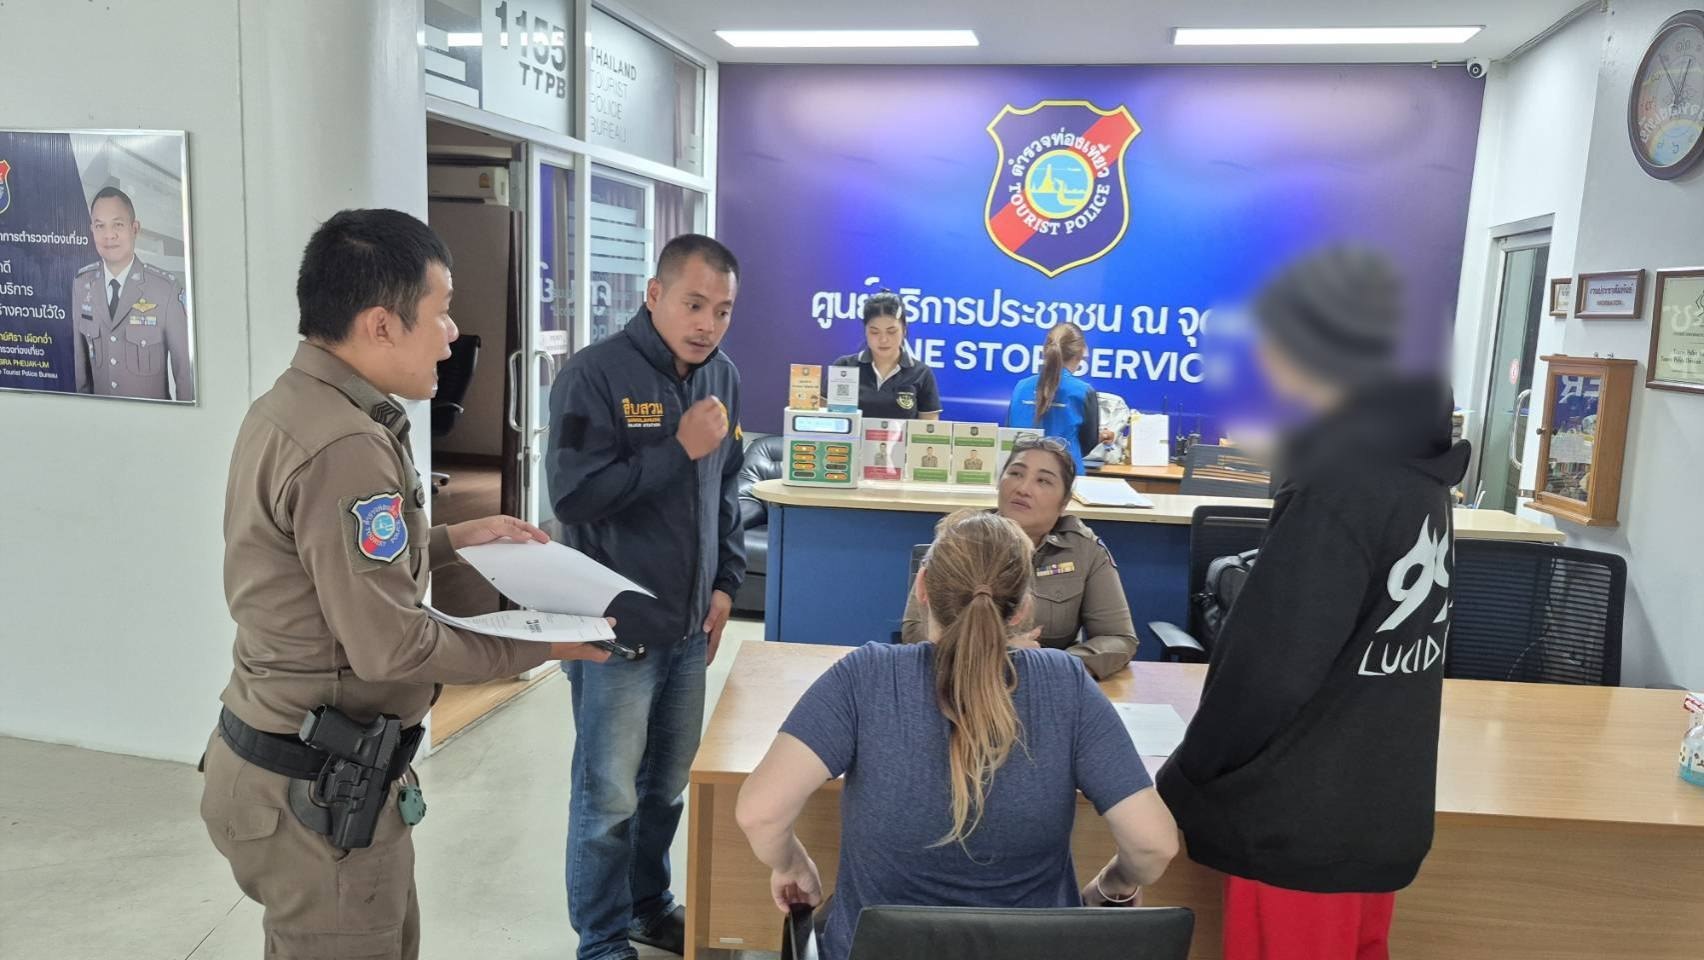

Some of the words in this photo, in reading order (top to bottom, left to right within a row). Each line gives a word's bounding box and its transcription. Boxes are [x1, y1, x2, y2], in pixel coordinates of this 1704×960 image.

[495, 2, 567, 72] 1155
[519, 61, 566, 99] TTPB
[591, 46, 637, 81] THAILAND
[590, 68, 628, 98] TOURIST
[590, 92, 623, 120] POLICE
[591, 116, 631, 145] BUREAU
[1008, 127, 1110, 179] ตำรวจท่องเที่ยว
[1008, 182, 1060, 235] TOURIST
[1064, 184, 1110, 234] POLICE
[1131, 305, 1169, 335] ณ
[902, 338, 945, 368] NE
[1073, 347, 1209, 384] ERVIC
